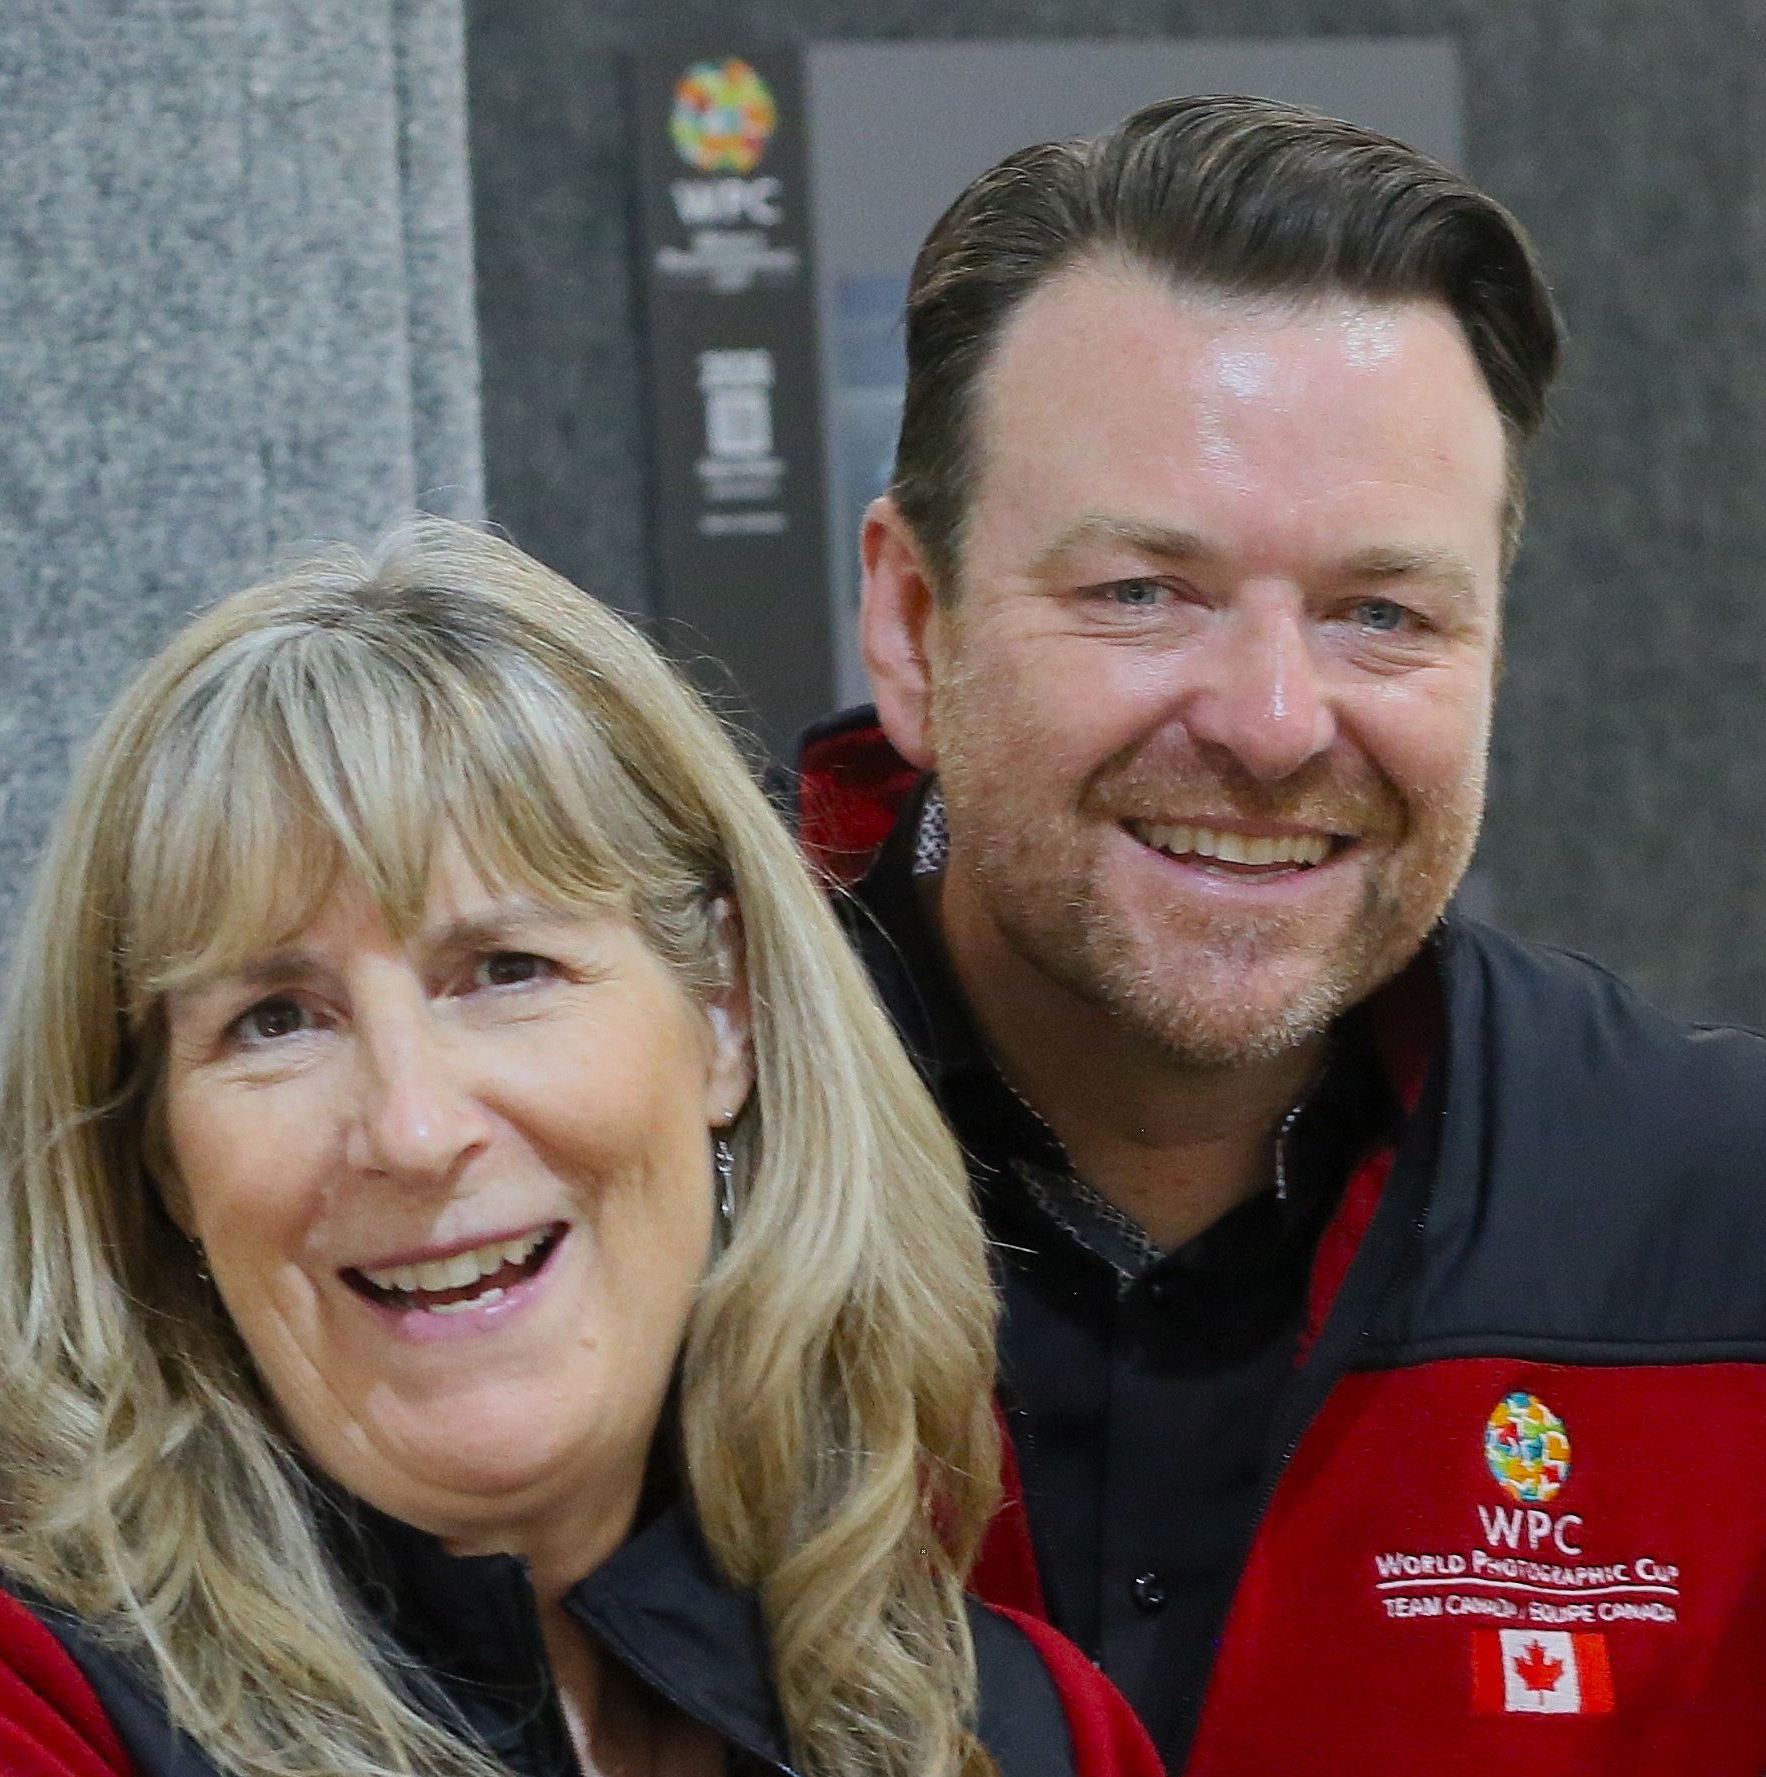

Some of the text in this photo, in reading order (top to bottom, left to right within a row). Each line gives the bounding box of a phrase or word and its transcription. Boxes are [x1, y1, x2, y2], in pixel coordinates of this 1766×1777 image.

[1478, 1504, 1584, 1556] WPC
[1375, 1549, 1680, 1587] WORLD PHOTOGRAPHIC CUP
[1382, 1595, 1443, 1618] TEAM
[1445, 1594, 1518, 1618] CANADA
[1597, 1602, 1678, 1622] CANADA
